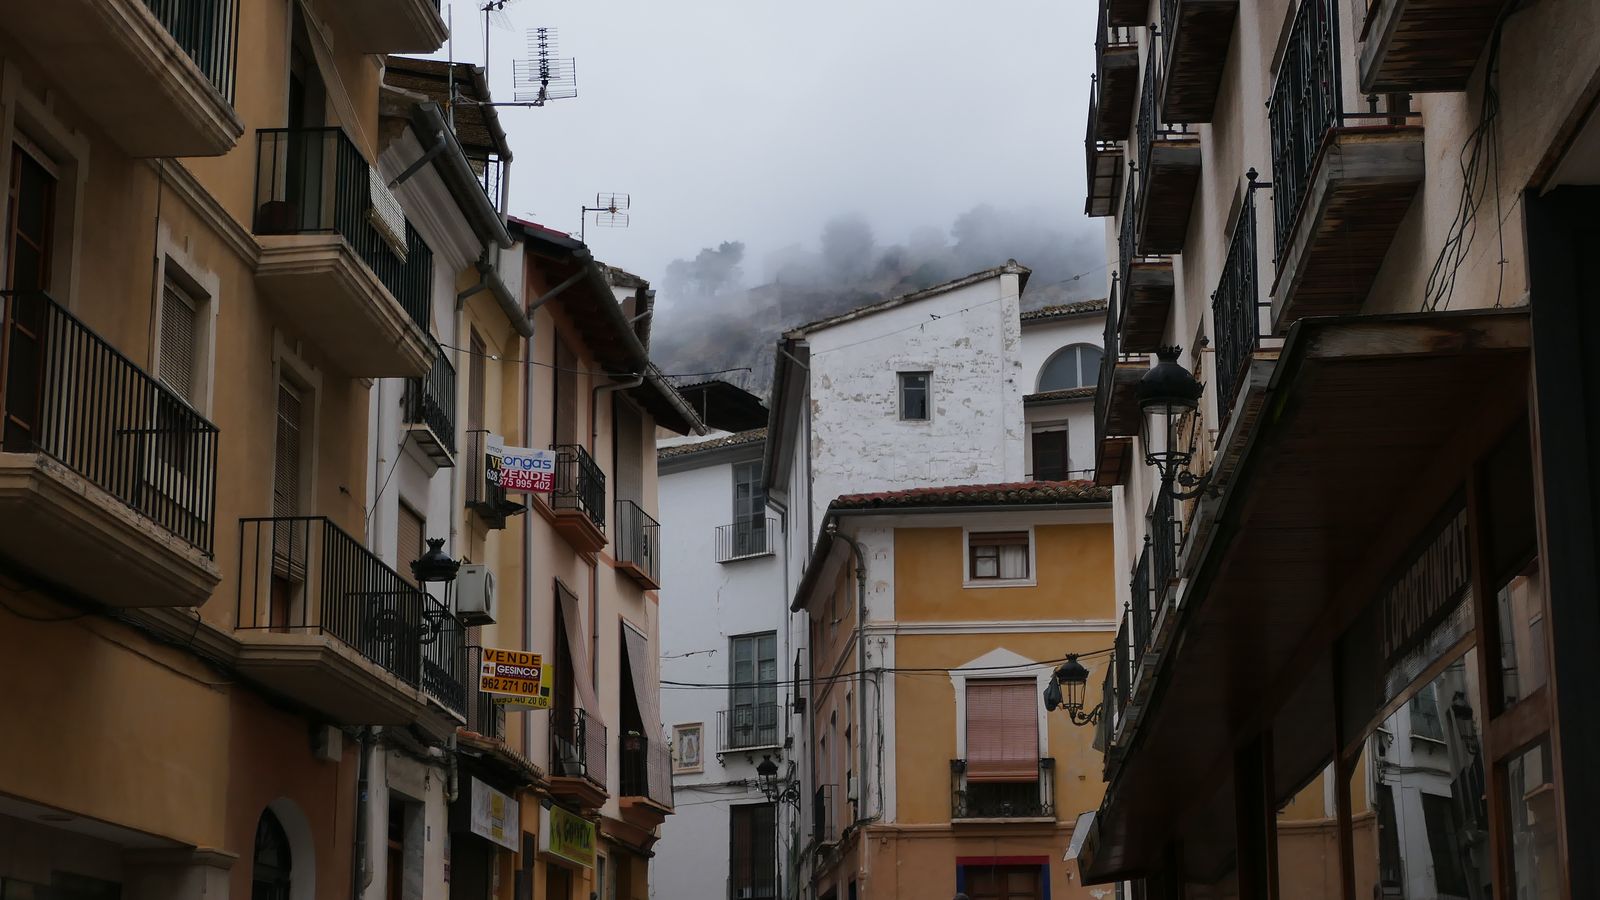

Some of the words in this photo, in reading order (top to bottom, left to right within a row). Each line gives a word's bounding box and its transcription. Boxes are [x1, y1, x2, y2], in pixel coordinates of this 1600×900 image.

[499, 469, 551, 481] VENDE
[516, 480, 531, 488] 995
[533, 481, 550, 490] 402
[485, 650, 541, 665] VENDE
[497, 665, 539, 676] GESINCO
[482, 678, 499, 689] 962
[502, 680, 519, 691] 271
[522, 682, 539, 694] 001
